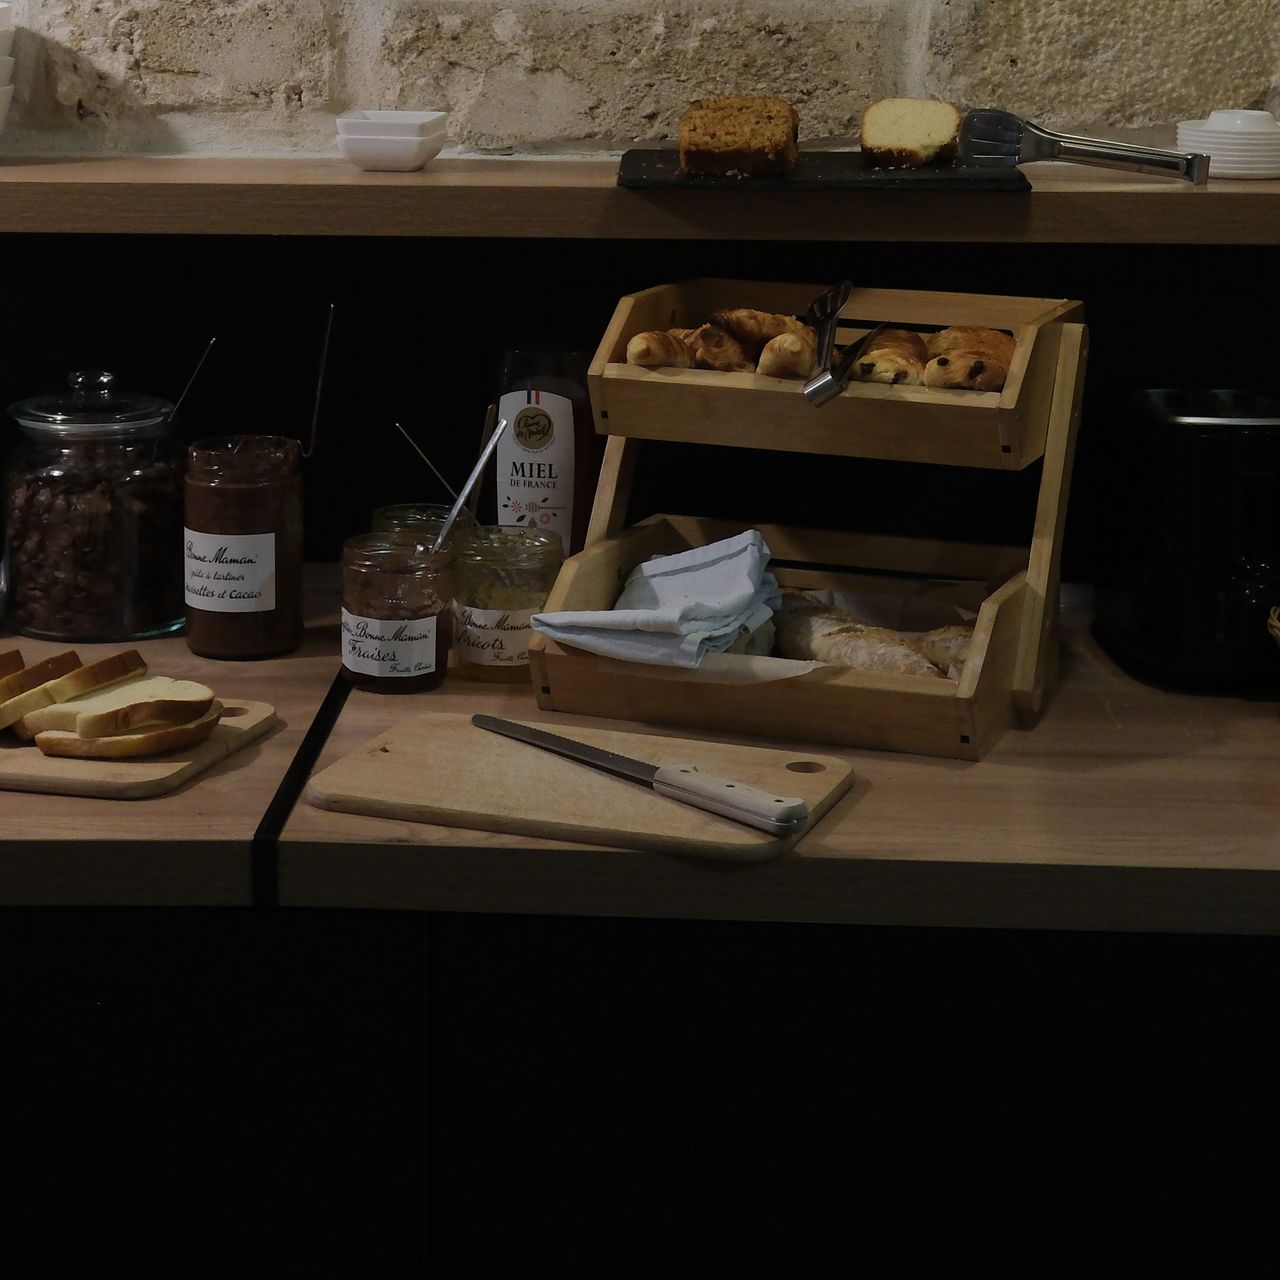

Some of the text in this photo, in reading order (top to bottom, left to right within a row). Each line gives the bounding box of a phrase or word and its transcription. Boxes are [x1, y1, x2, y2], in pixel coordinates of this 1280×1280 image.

[510, 461, 558, 479] MIEL
[510, 479, 558, 489] DE FRANCE
[186, 540, 257, 564] Bonne Maman
[213, 571, 245, 581] tartiner
[218, 589, 226, 599] et
[461, 610, 489, 630] Bonne
[355, 621, 387, 642] Bonne
[387, 624, 431, 642] Maman
[348, 639, 400, 662] Fraises
